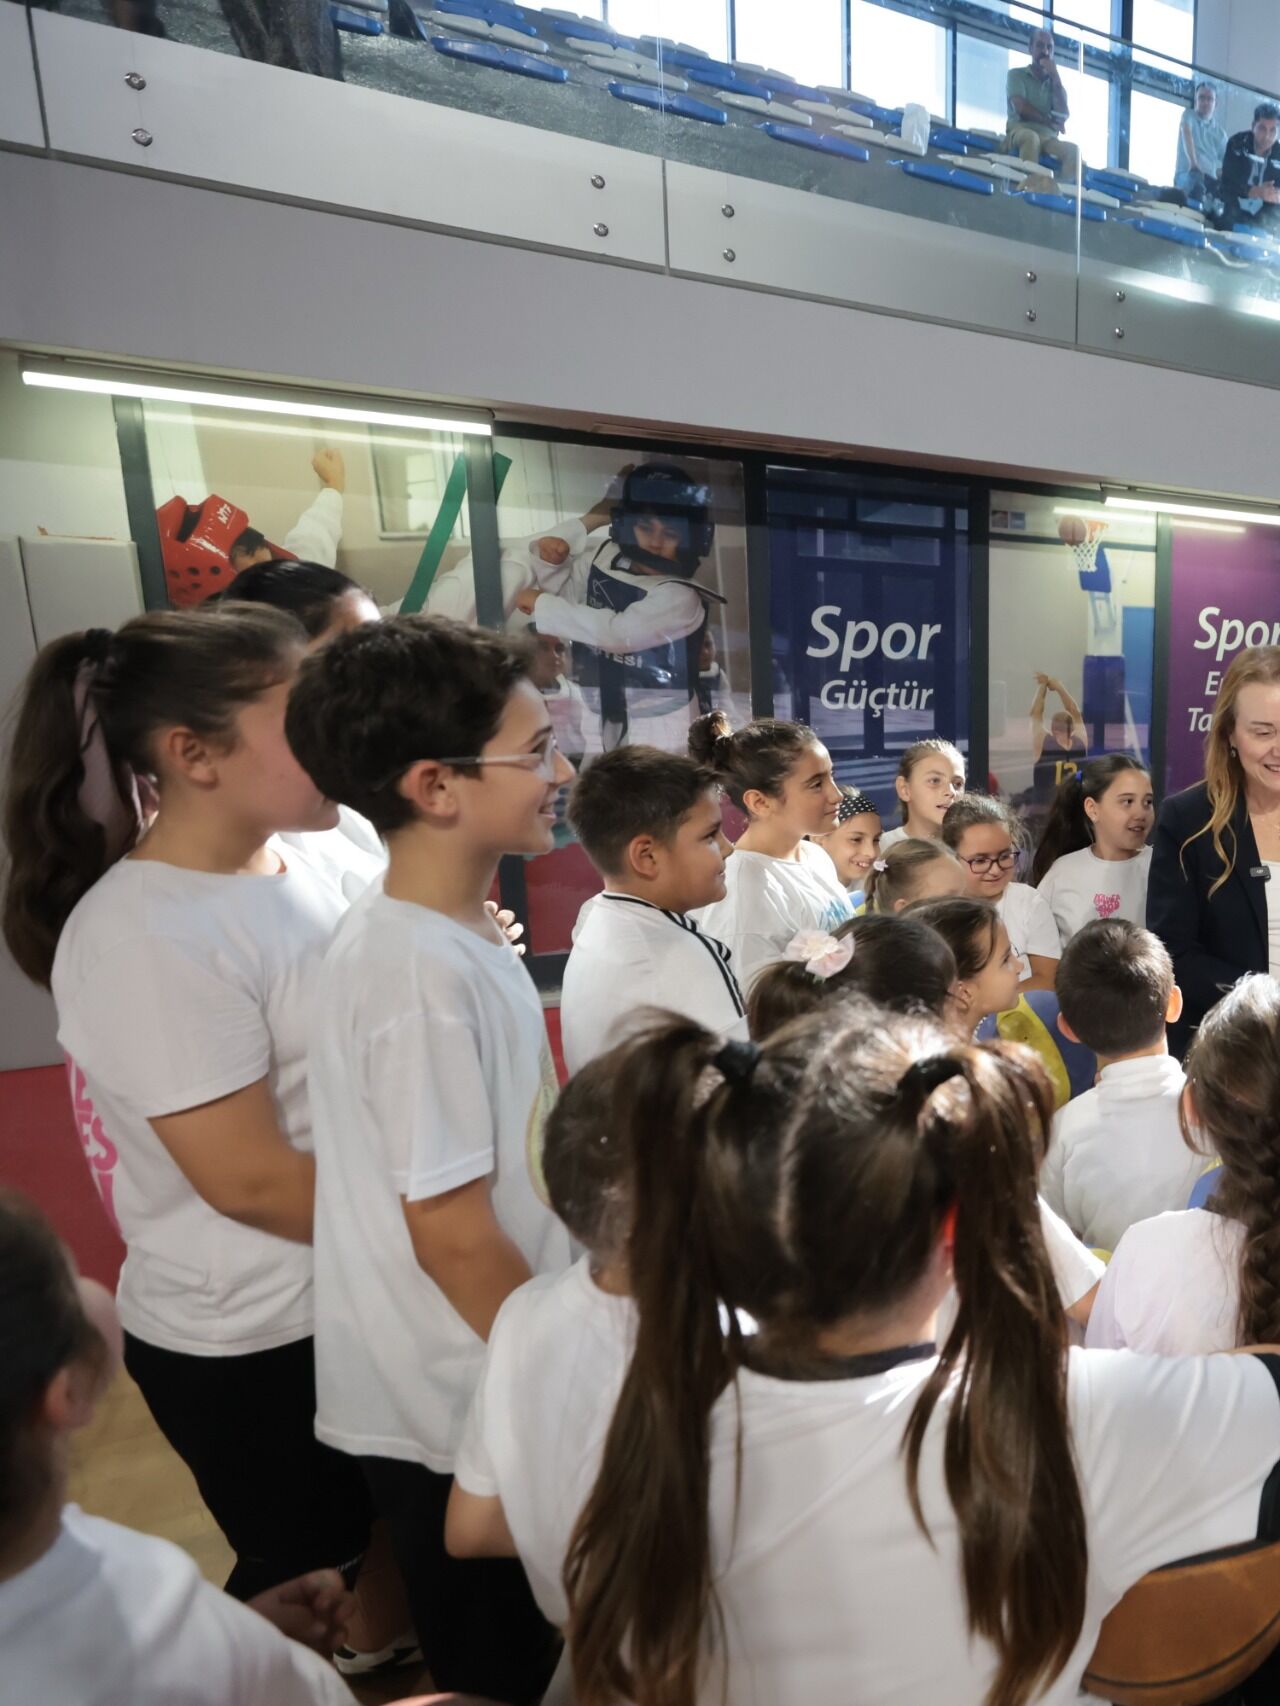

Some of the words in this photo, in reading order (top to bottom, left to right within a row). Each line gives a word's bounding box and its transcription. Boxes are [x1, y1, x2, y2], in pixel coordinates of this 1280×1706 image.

[806, 605, 942, 672] Spor
[820, 679, 934, 718] Güçtür
[1204, 671, 1224, 696] E
